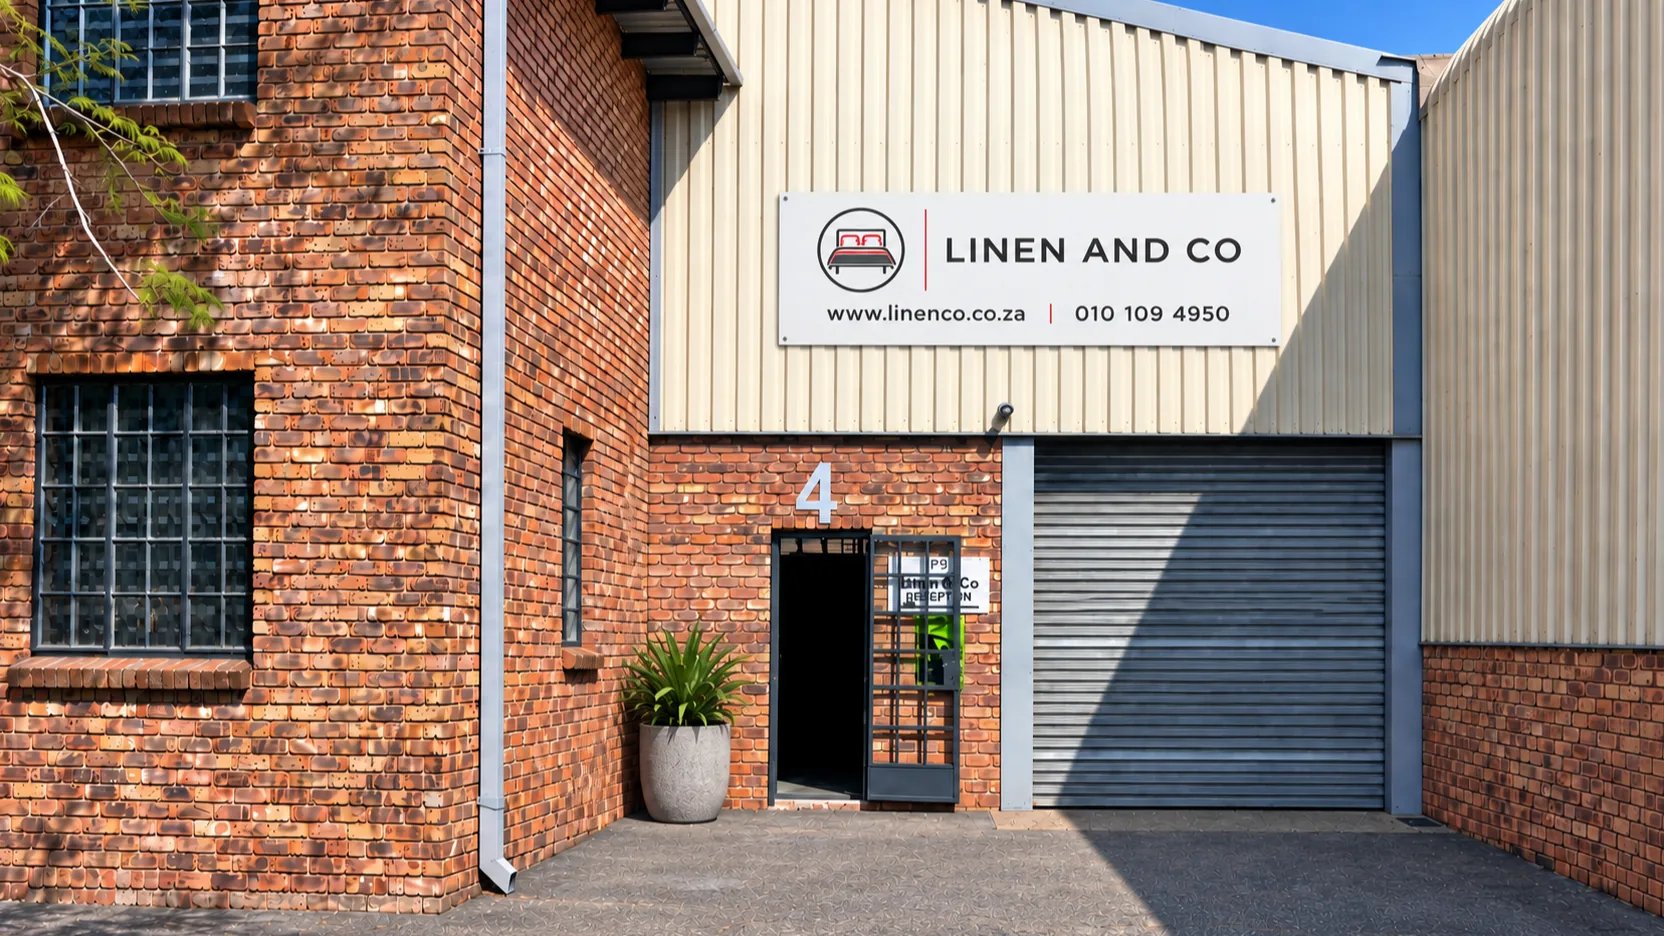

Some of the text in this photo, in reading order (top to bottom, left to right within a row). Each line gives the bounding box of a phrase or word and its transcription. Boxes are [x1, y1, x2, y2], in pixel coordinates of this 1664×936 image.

[945, 236, 1243, 264] LINEN AND CO
[826, 304, 1026, 323] www.linenco.co.za
[1074, 305, 1231, 323] 010 109 4950
[795, 461, 838, 524] 4
[930, 558, 948, 571] P9
[959, 576, 980, 590] Co
